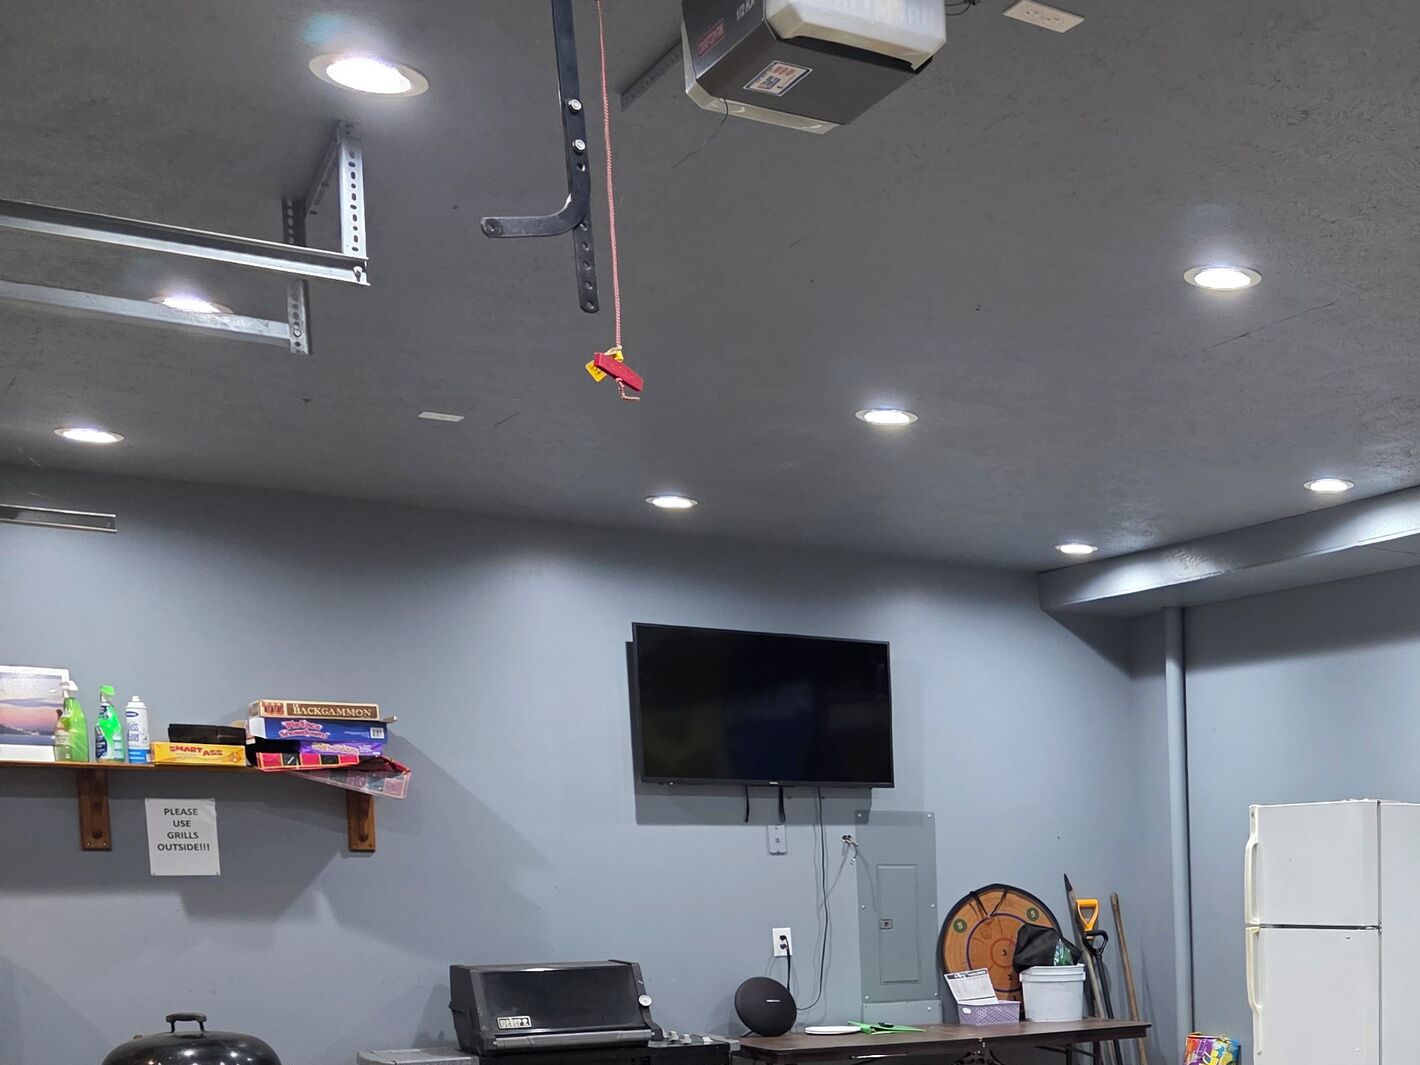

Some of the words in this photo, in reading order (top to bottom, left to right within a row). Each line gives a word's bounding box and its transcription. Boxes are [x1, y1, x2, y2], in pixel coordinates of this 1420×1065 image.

[293, 704, 371, 717] BACKGAMMON
[169, 745, 202, 754] SMART
[163, 808, 199, 816] PLEASE
[173, 820, 192, 828] USE
[167, 832, 199, 840] GRILLS
[157, 843, 210, 851] OUTSIDE!!!
[1002, 949, 1008, 957] 3
